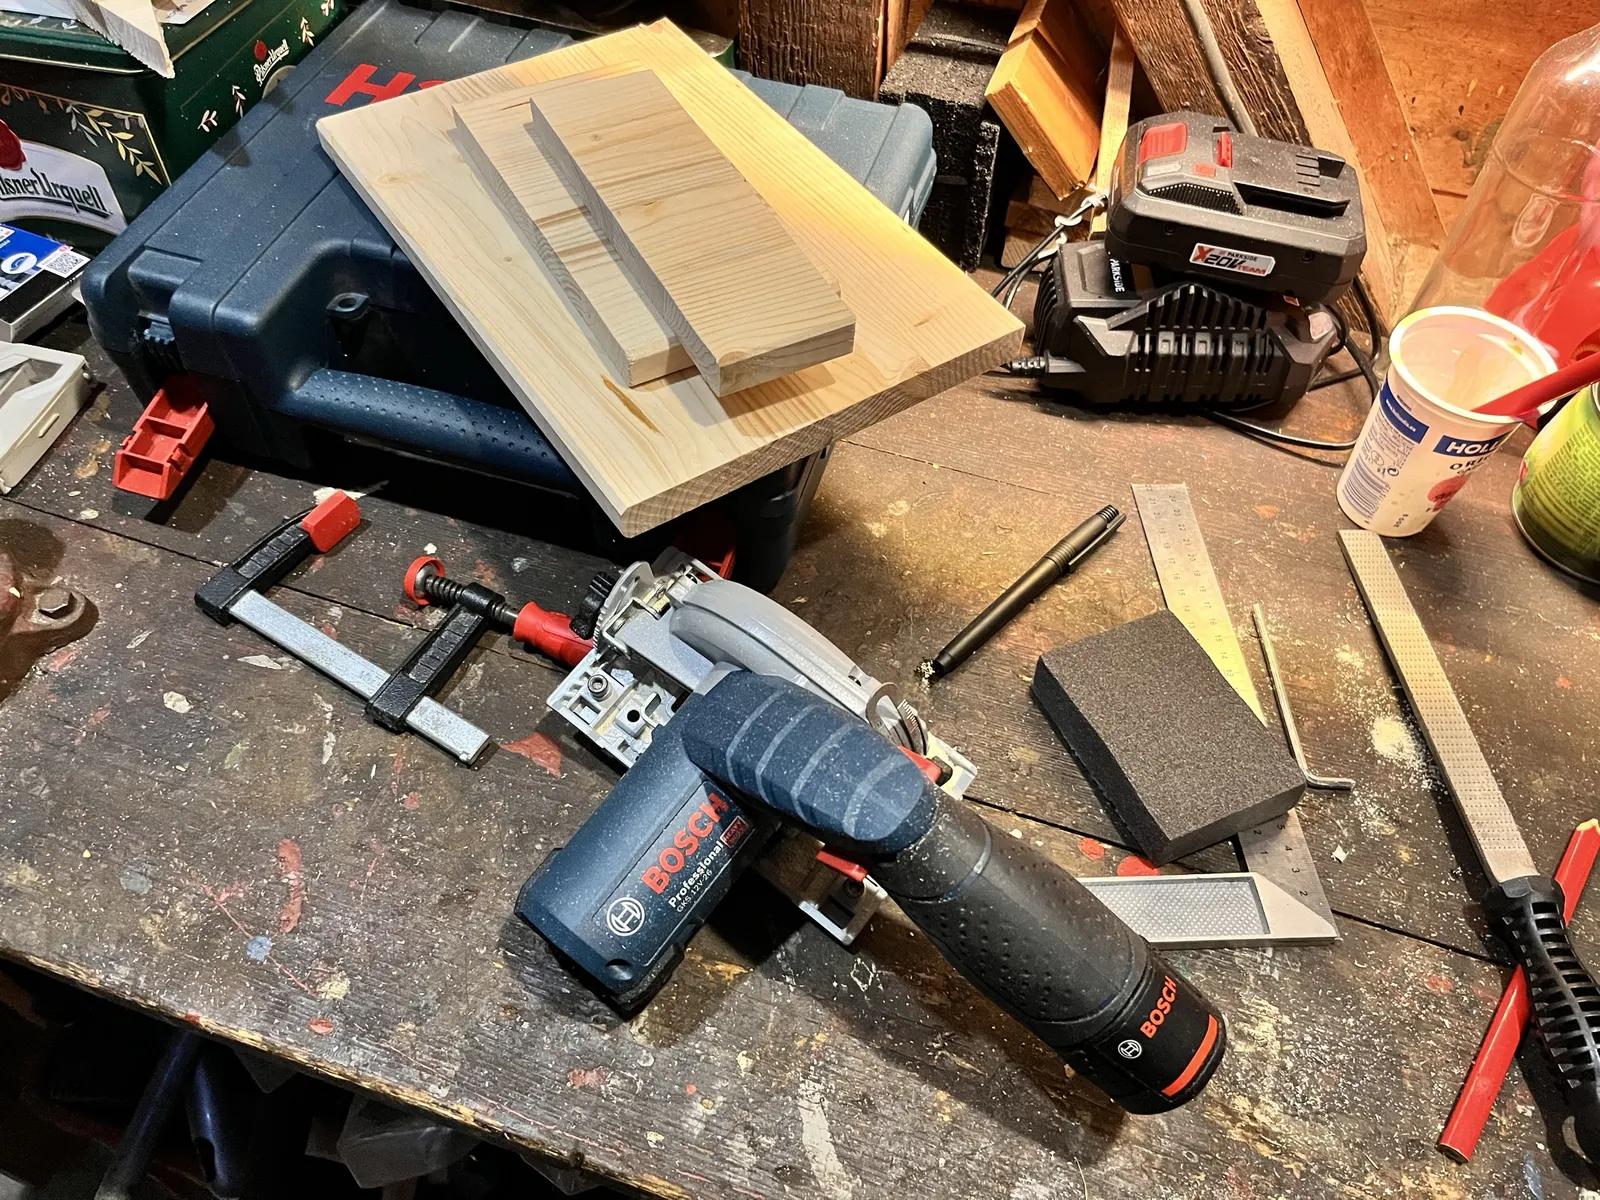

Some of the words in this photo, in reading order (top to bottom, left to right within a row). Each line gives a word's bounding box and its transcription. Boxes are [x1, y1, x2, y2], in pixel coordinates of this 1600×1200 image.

[30, 167, 108, 213] Urquell
[1227, 252, 1258, 262] PARKSIDE
[1237, 264, 1267, 275] TEAM
[640, 792, 729, 895] BOSCH
[668, 840, 724, 908] Professional
[676, 895, 692, 913] GKS
[1139, 975, 1178, 1039] BOSCH
